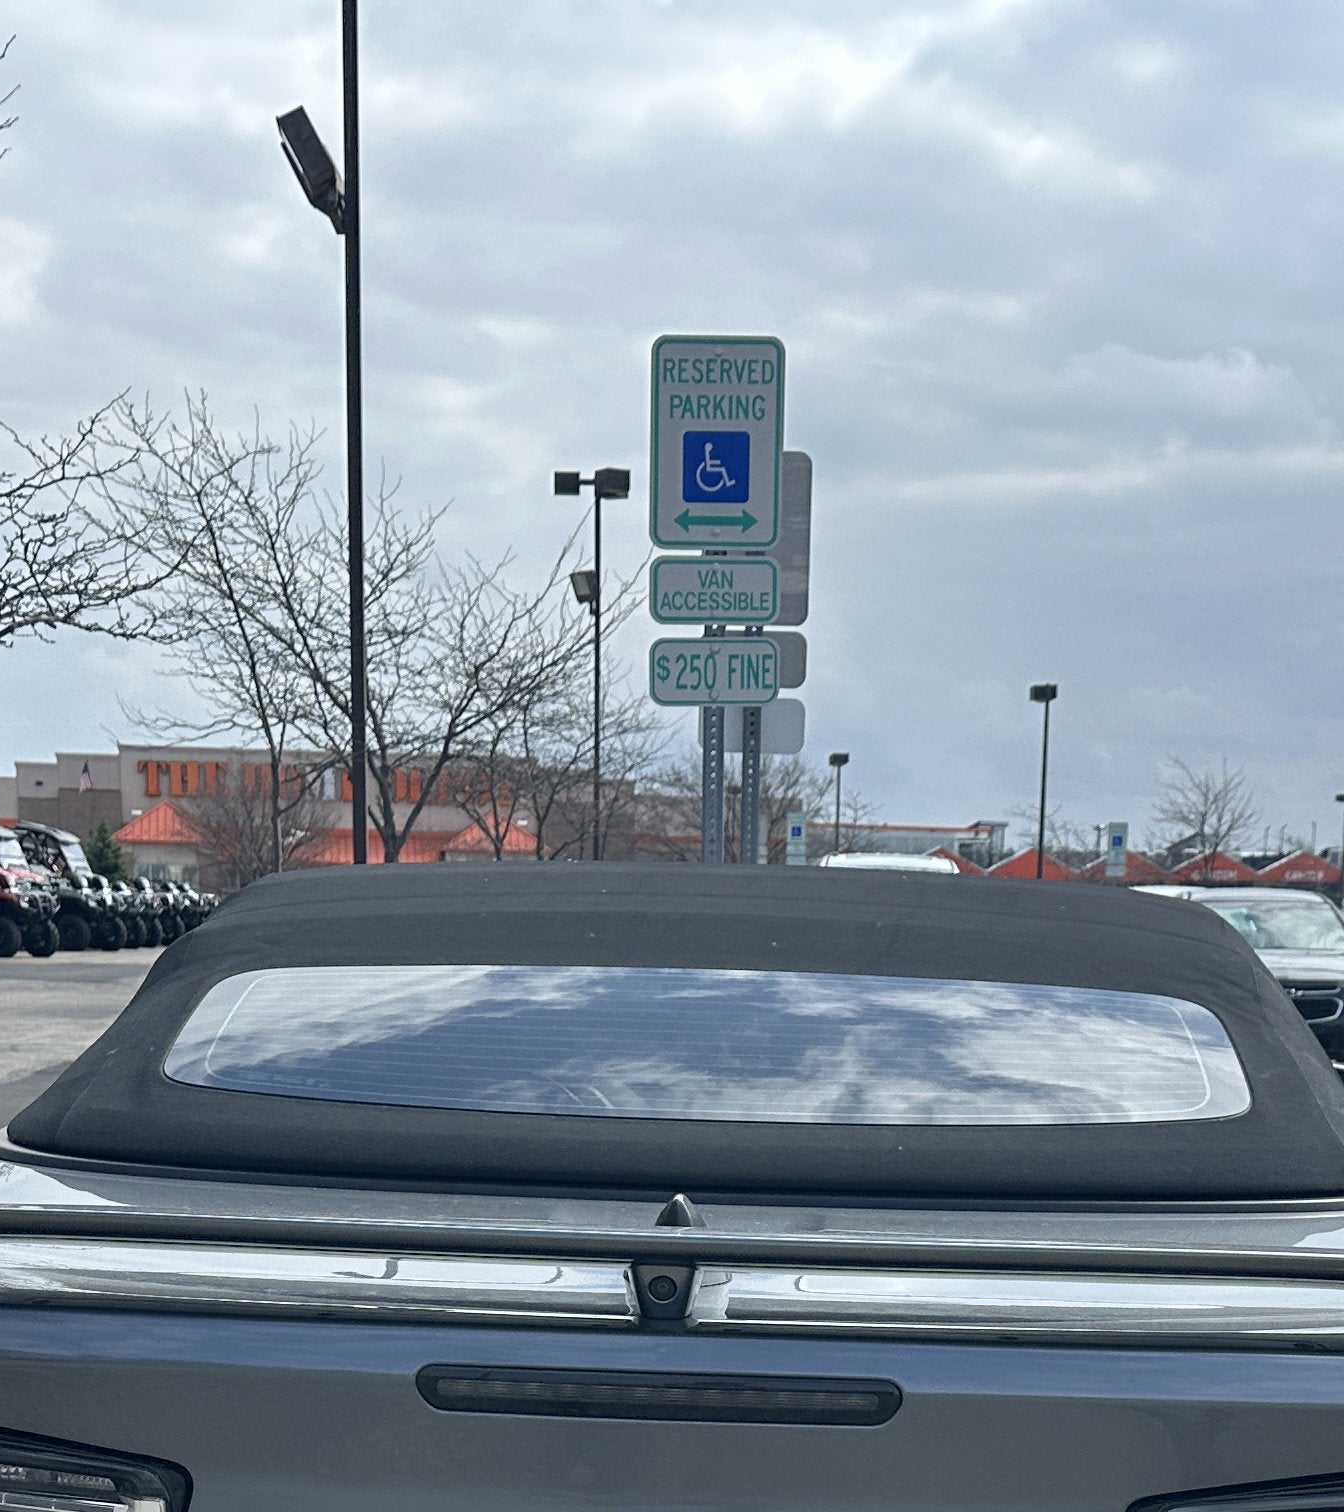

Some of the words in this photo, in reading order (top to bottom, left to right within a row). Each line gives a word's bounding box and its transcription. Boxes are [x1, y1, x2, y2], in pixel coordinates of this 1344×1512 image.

[662, 357, 775, 385] RESERVED
[669, 393, 766, 421] PARKING
[697, 569, 734, 589] VAN
[659, 590, 771, 611] ACCESSIBLE
[727, 653, 774, 690] FINE
